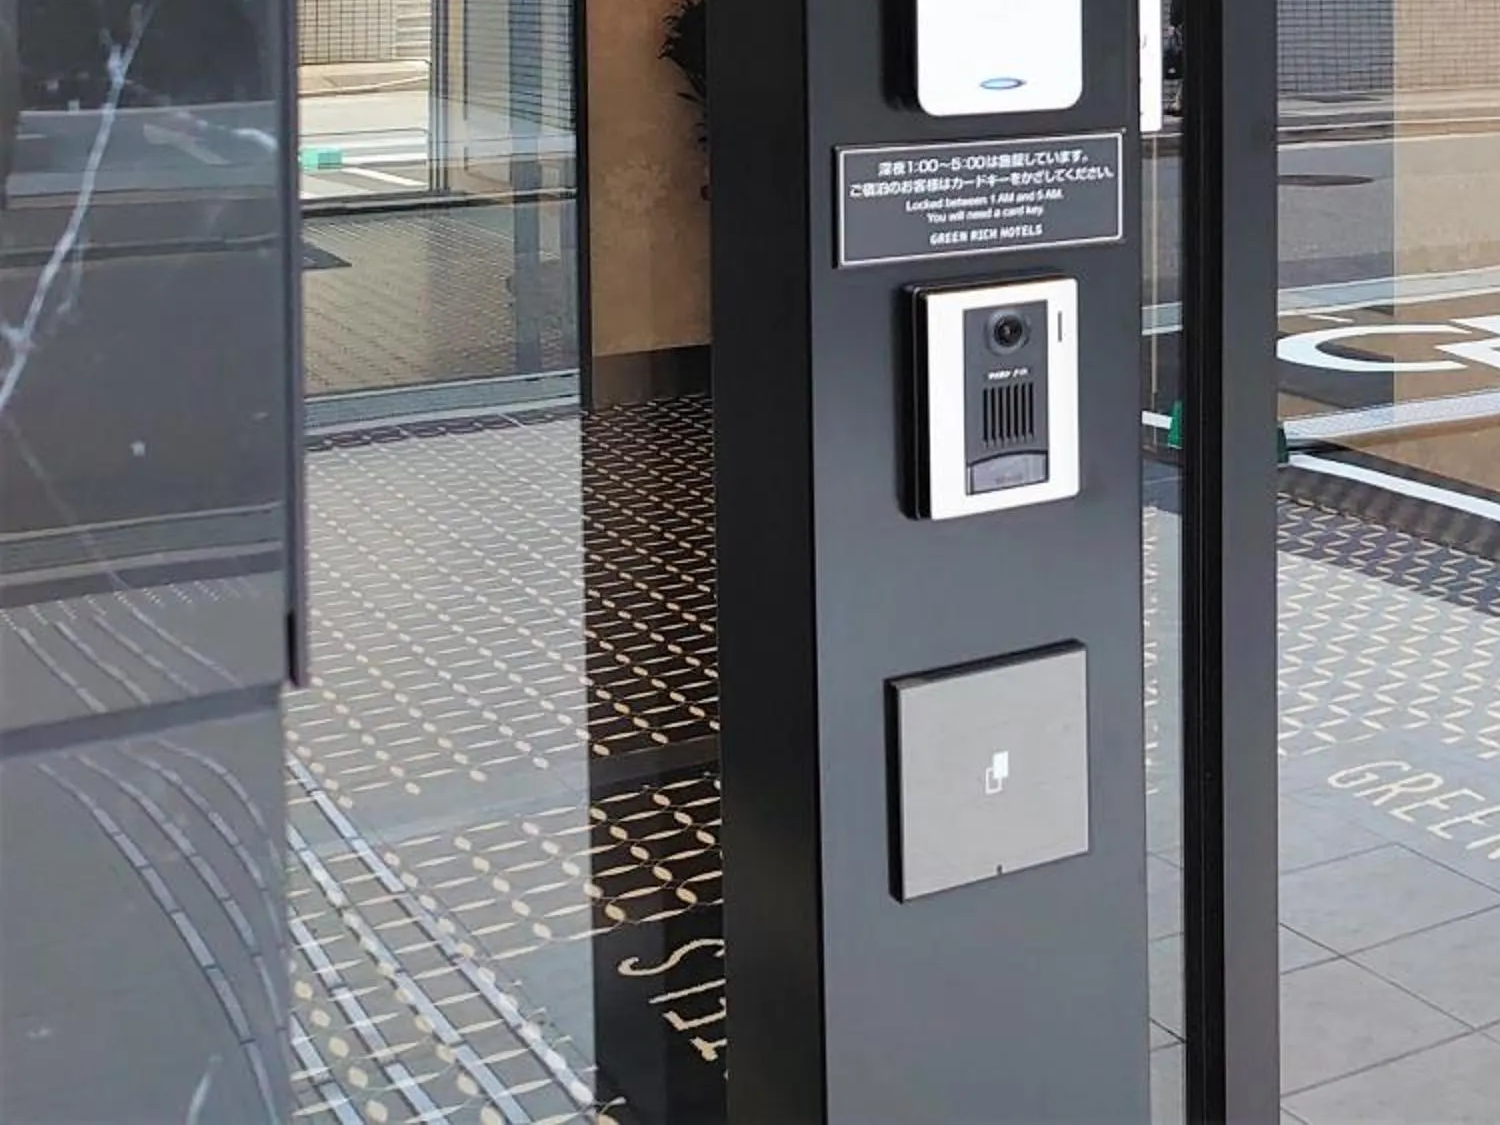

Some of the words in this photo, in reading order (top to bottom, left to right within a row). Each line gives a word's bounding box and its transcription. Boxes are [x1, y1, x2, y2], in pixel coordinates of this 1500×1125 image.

[997, 191, 1015, 203] AM
[1016, 190, 1035, 202] and
[928, 230, 968, 246] GREEN
[970, 227, 998, 242] RICH
[1000, 222, 1043, 240] HOTELS
